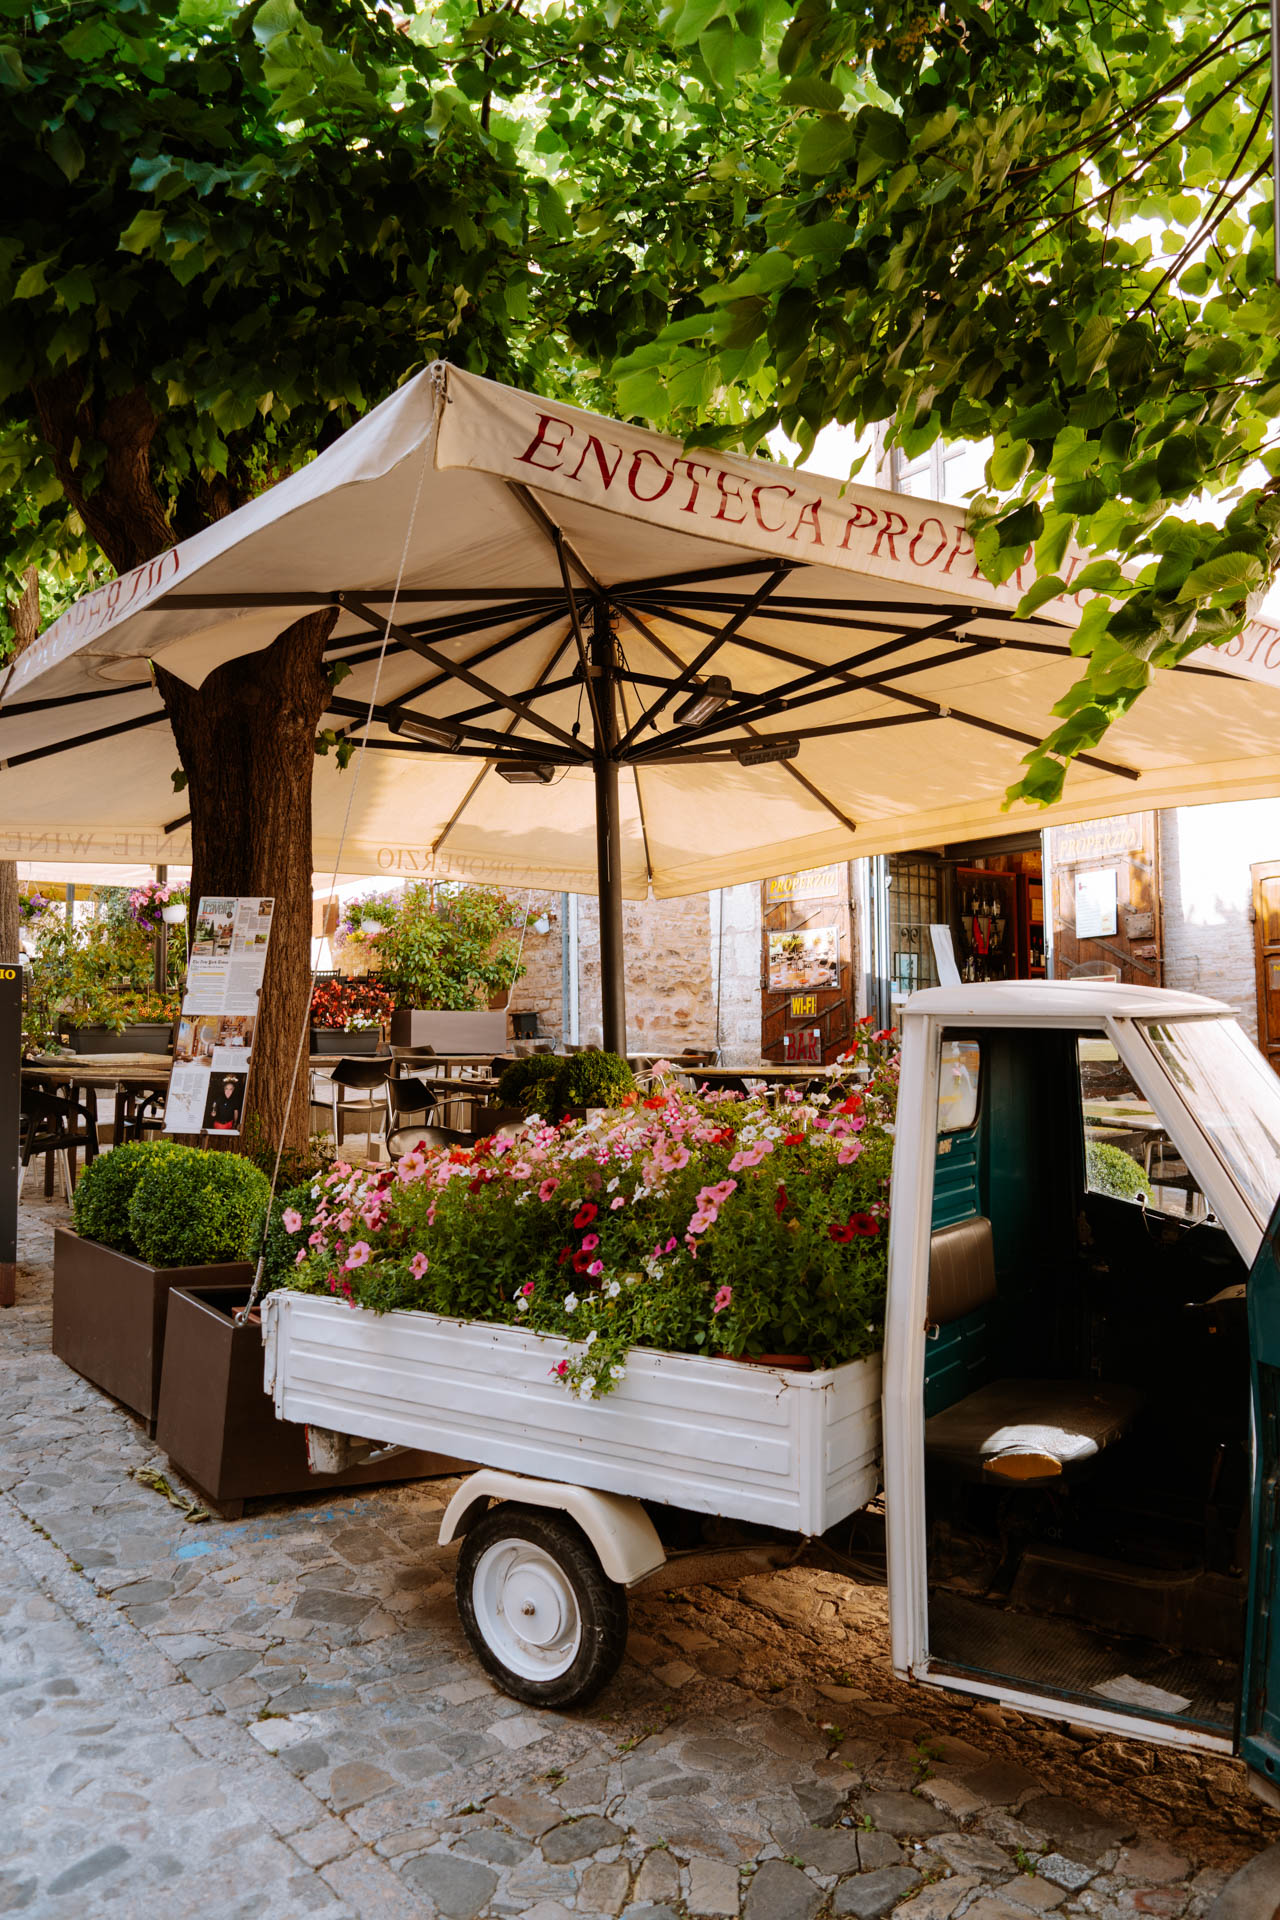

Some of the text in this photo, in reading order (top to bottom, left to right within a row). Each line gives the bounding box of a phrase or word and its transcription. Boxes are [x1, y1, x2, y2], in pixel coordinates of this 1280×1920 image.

[515, 413, 825, 546] ENOTECA
[770, 873, 837, 894] PROPERZIO
[203, 902, 235, 914] Traveler
[792, 996, 815, 1016] WI-FI
[786, 1033, 818, 1060] BAR
